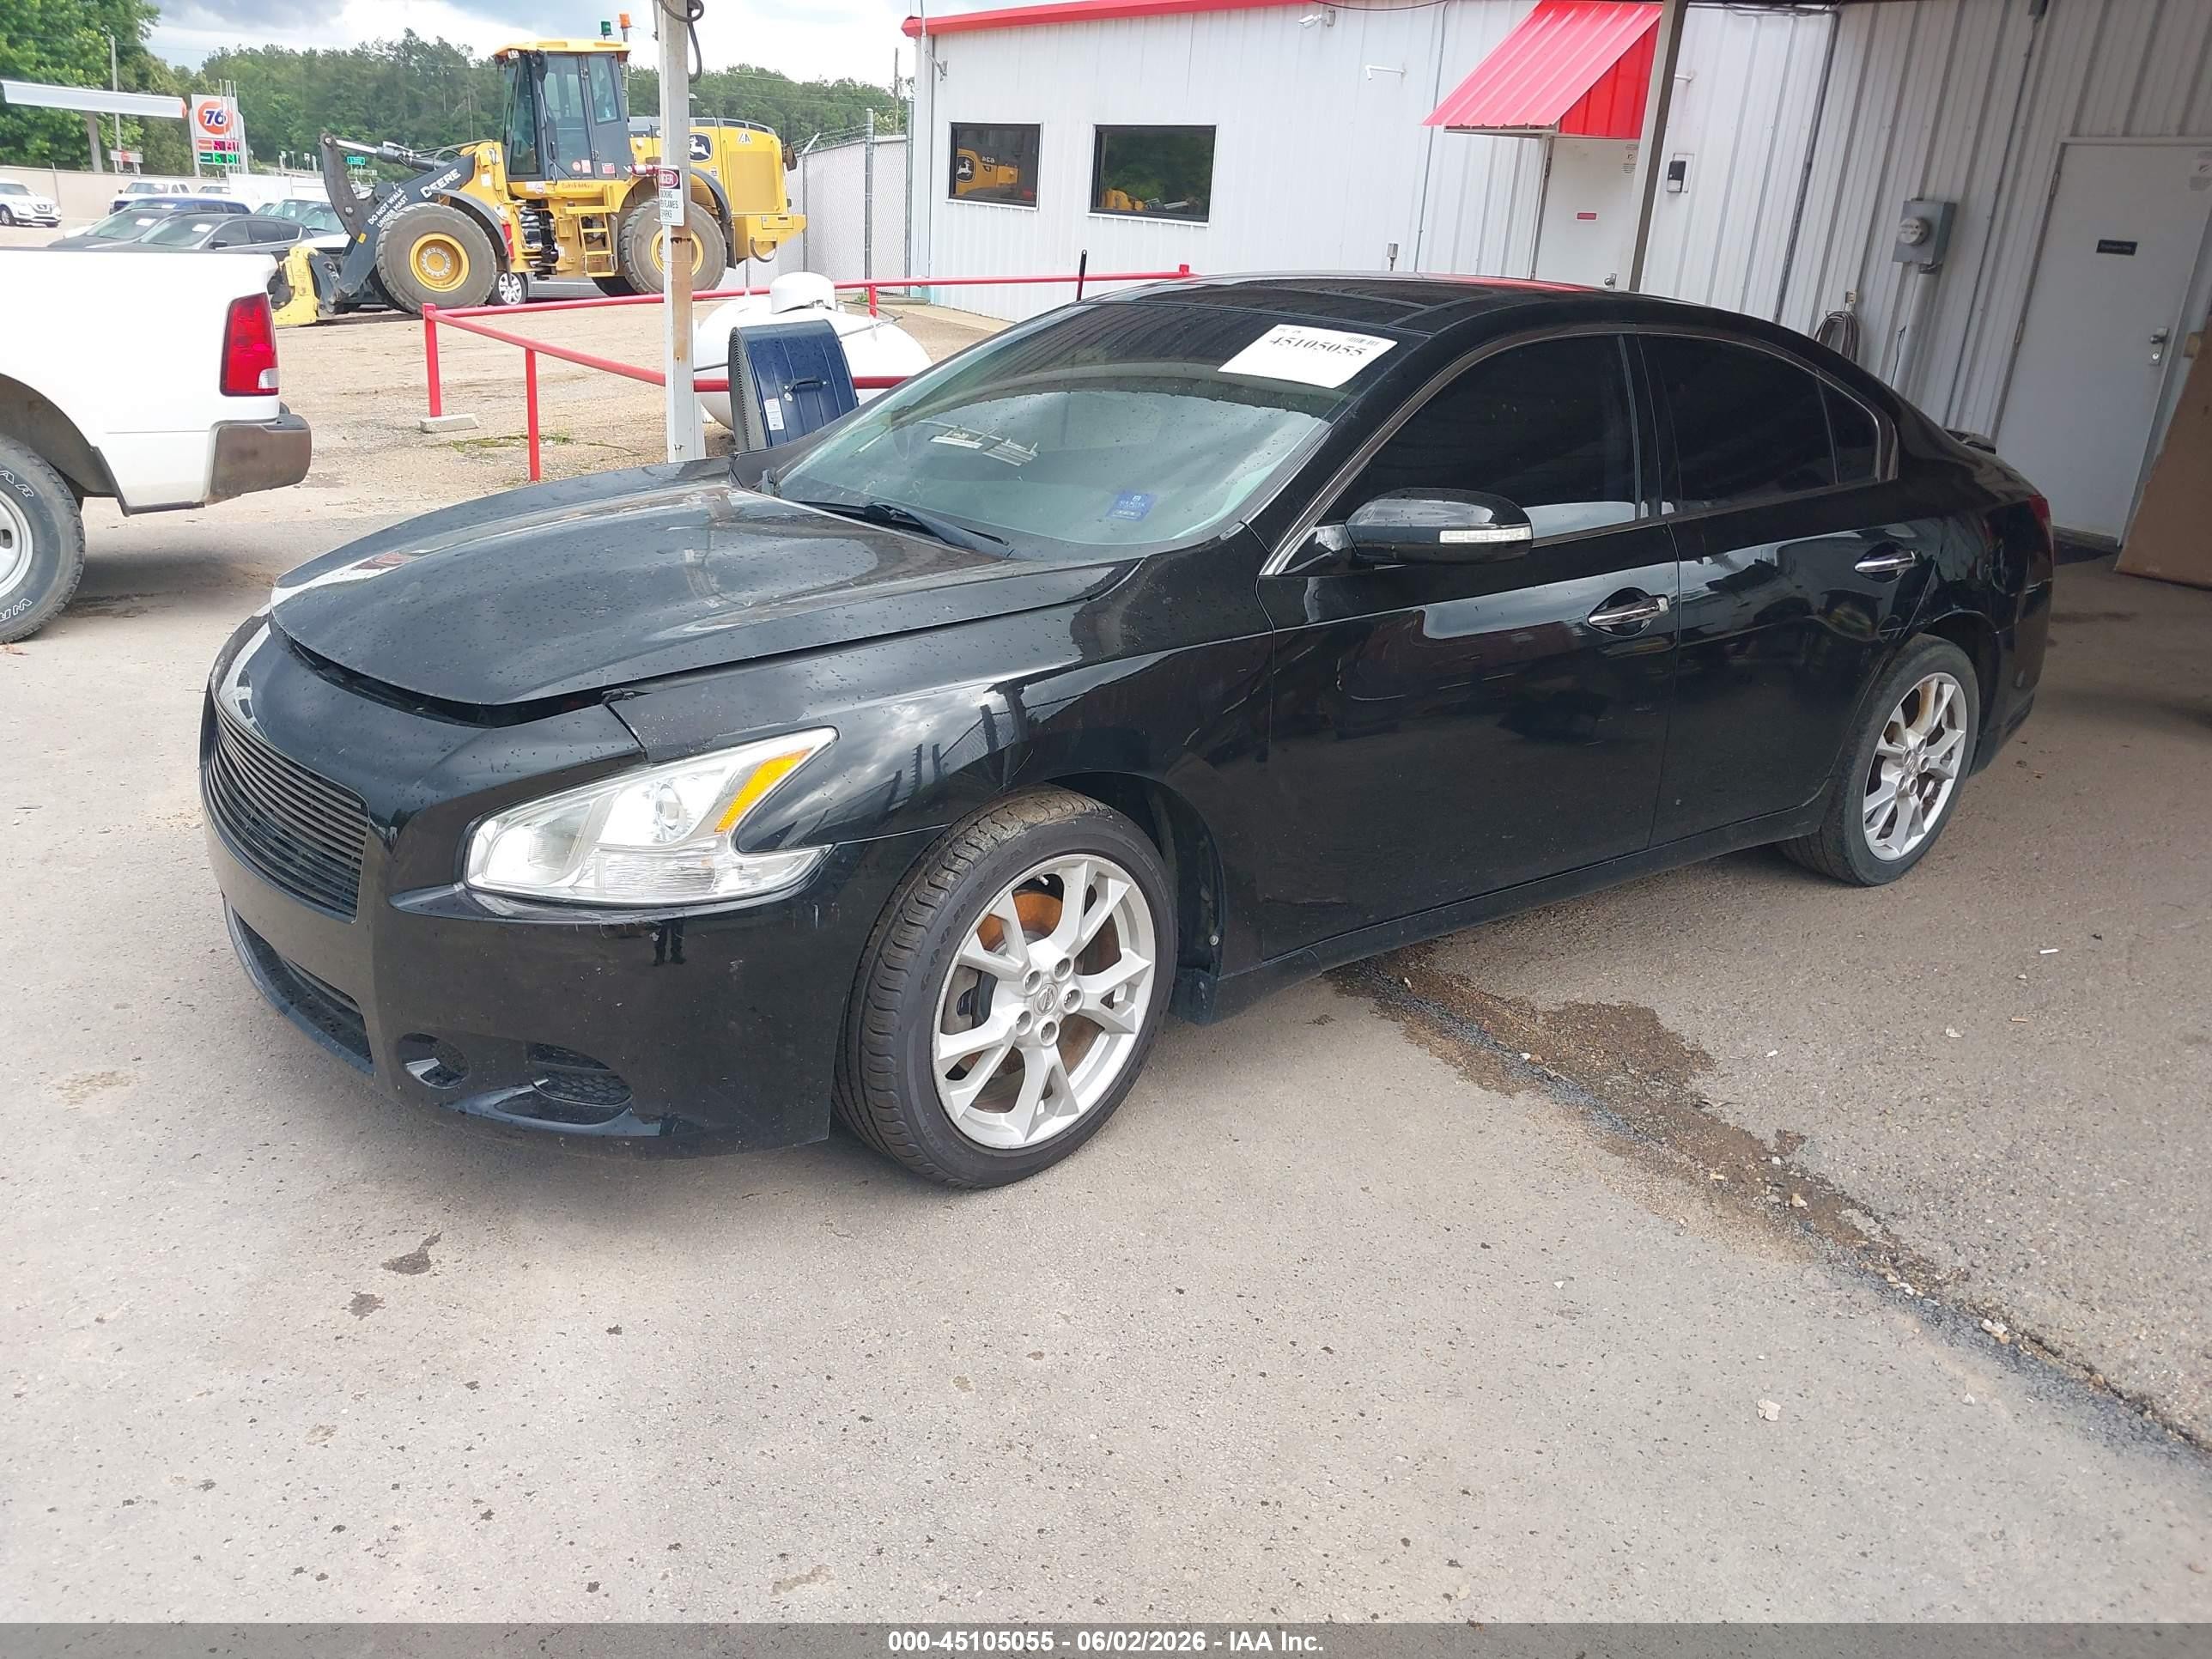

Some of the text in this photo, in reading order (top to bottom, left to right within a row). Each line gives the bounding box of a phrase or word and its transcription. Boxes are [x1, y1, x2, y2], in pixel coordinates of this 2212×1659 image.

[204, 109, 227, 125] 76
[420, 168, 461, 198] DEERE
[368, 188, 406, 225] DO NOT WALK
[376, 194, 410, 228] UNDER MAST
[1269, 336, 1368, 356] 45105055
[0, 470, 34, 498] AR
[0, 598, 33, 622] WR
